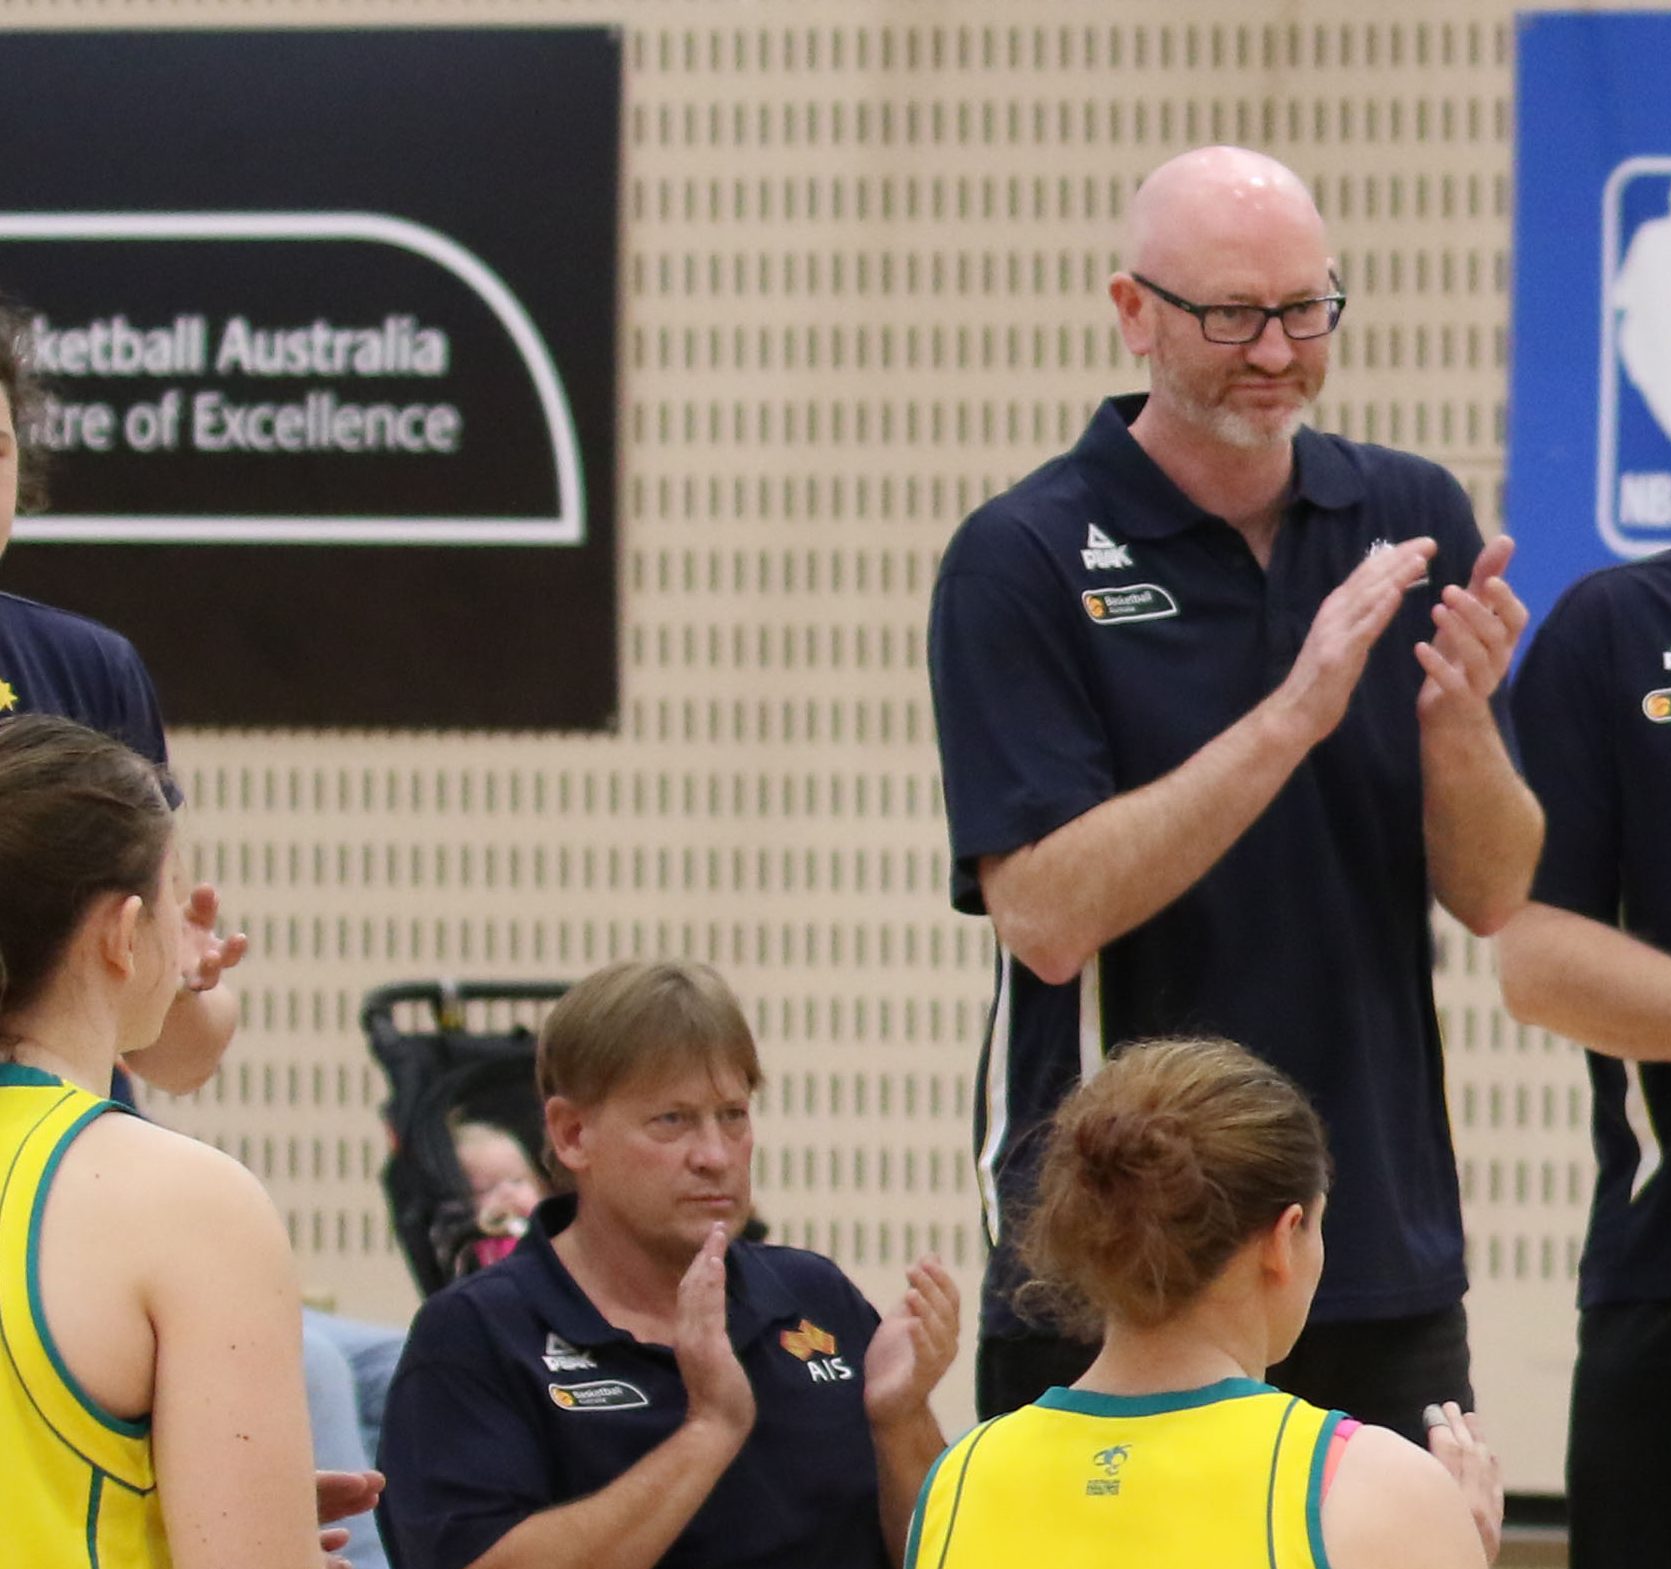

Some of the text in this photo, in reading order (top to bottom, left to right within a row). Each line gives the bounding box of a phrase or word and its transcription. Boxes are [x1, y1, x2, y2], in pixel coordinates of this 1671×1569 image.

[33, 315, 449, 375] ketball Australia
[125, 390, 182, 450] of
[194, 390, 461, 452] Excellence
[808, 1356, 854, 1384] AIS
